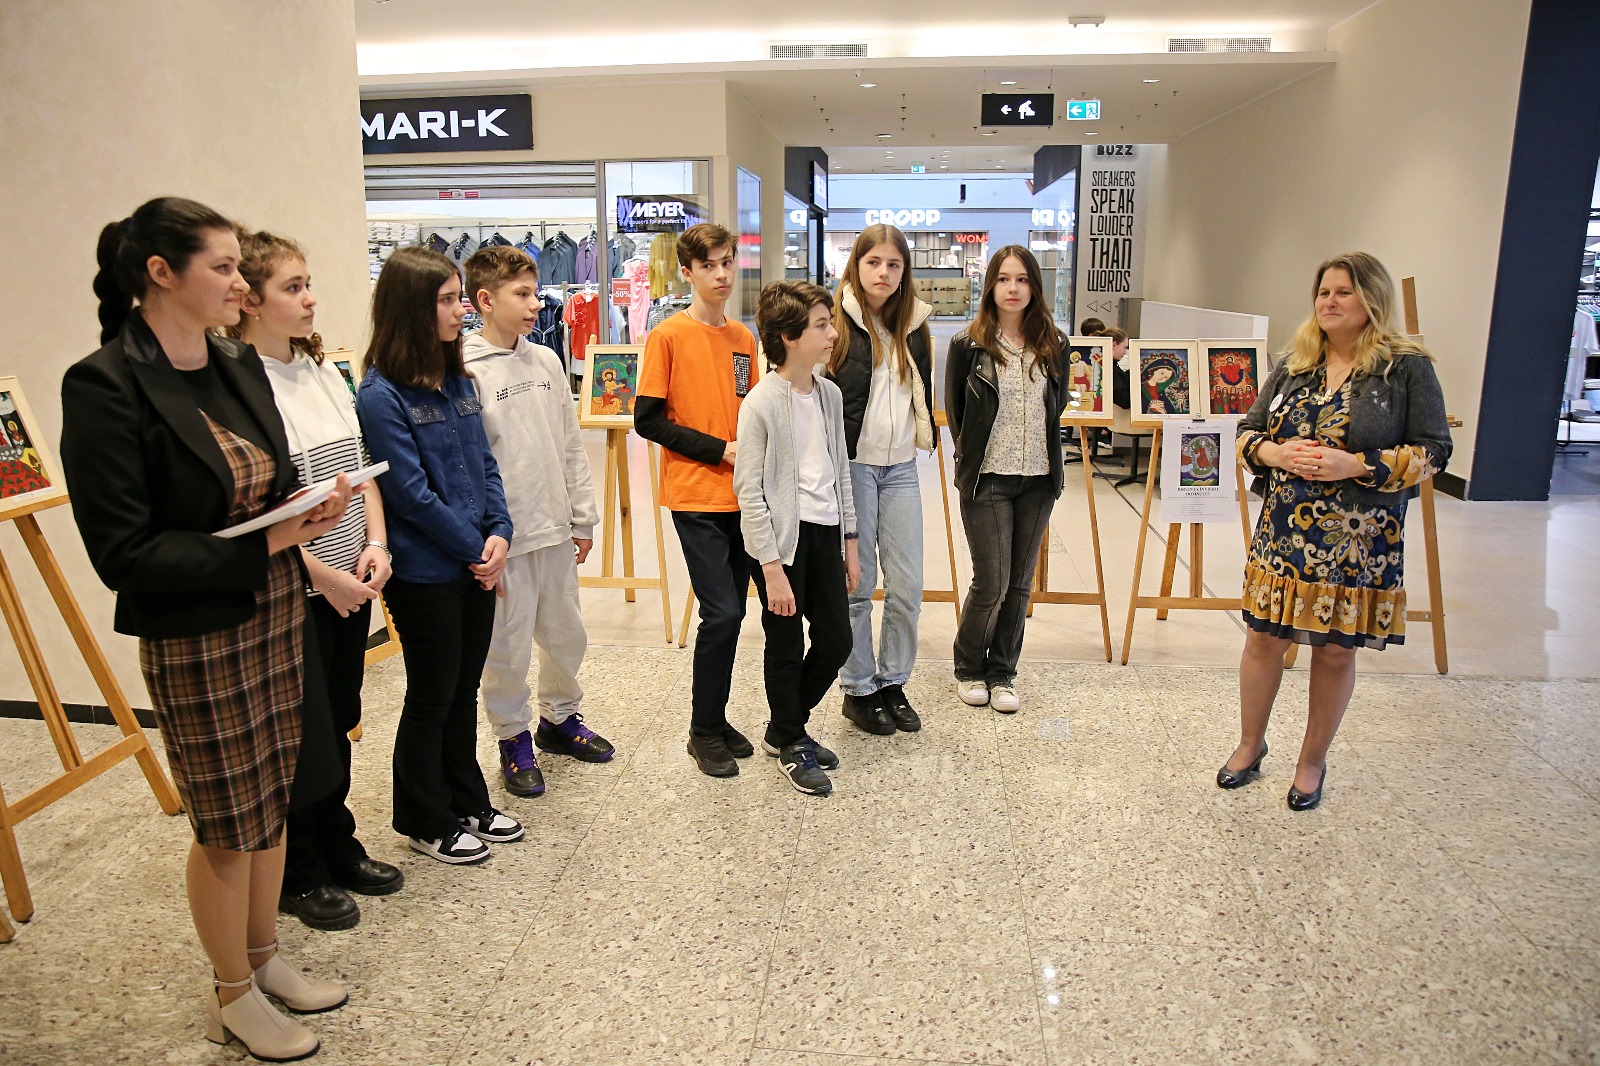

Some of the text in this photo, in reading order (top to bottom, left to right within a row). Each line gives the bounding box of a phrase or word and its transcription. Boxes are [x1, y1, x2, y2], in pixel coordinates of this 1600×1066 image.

[360, 108, 510, 141] MARI-K
[1096, 145, 1134, 156] BUZZ
[1092, 171, 1136, 187] SNEAKERS
[628, 202, 686, 217] MEYER
[1090, 188, 1135, 214] SPEAK
[865, 209, 941, 227] CROPP
[1089, 215, 1134, 237] LOUDER
[1089, 237, 1133, 270] THAN
[1087, 269, 1131, 293] WORDS
